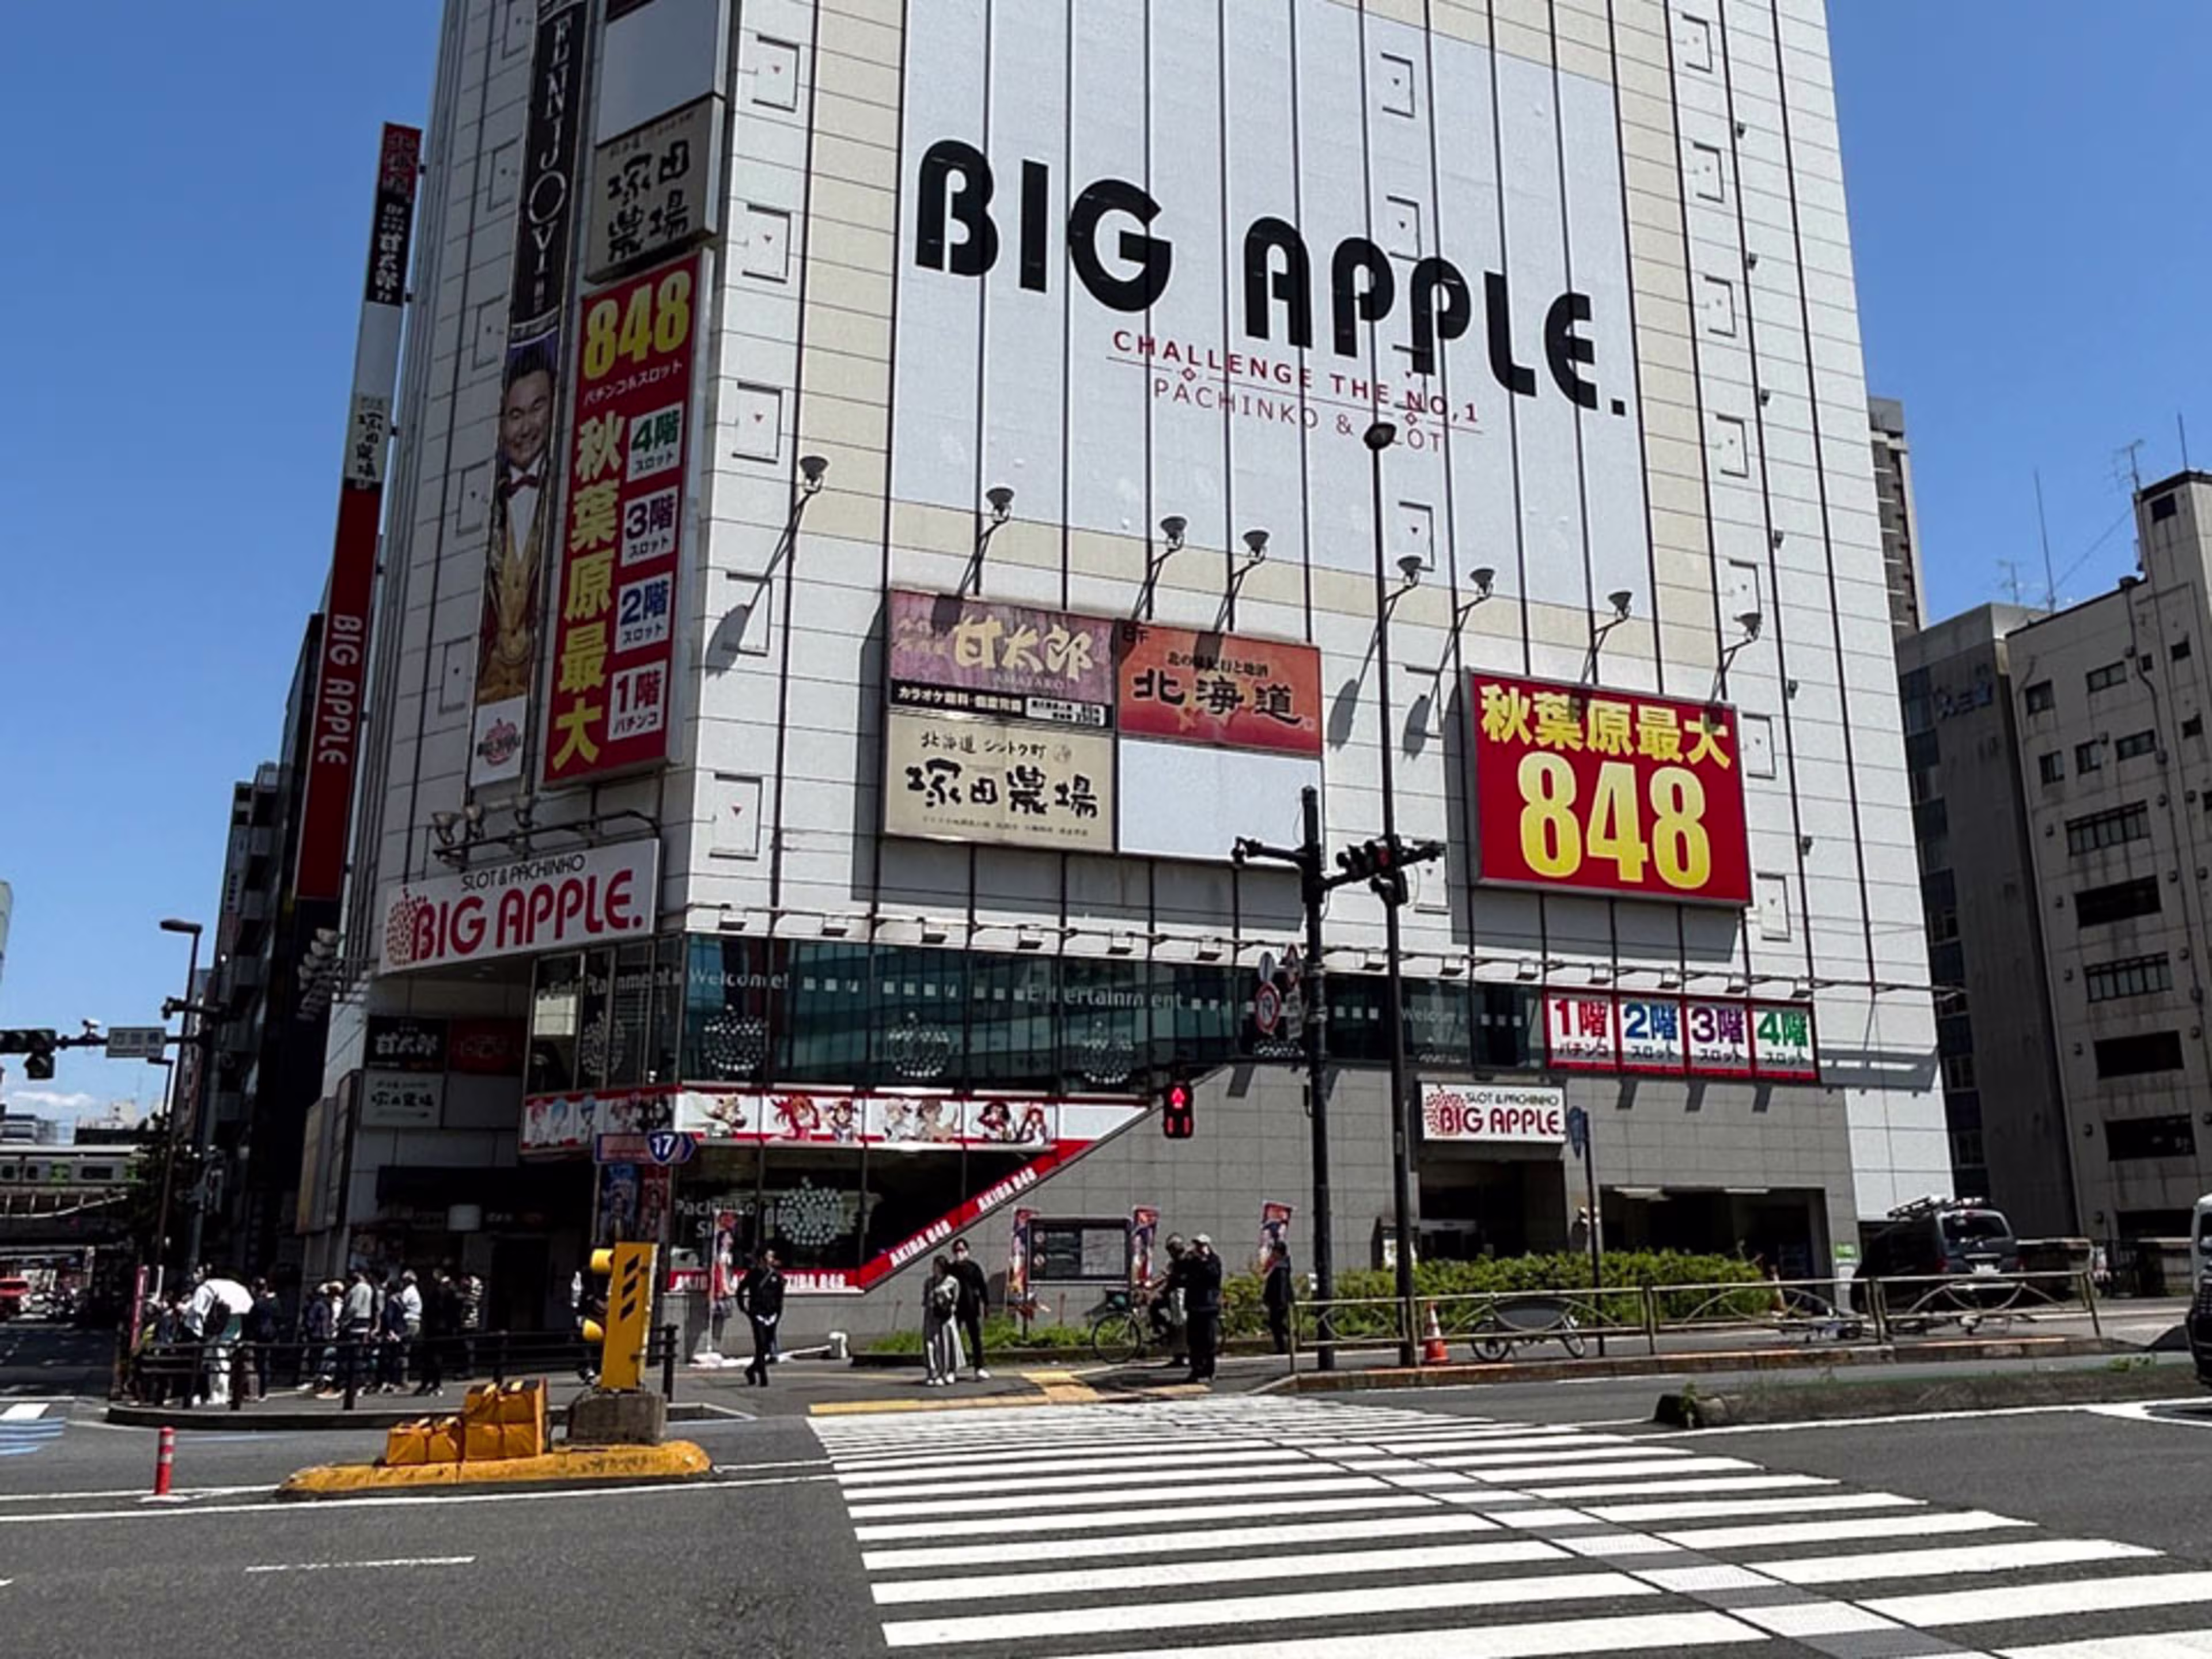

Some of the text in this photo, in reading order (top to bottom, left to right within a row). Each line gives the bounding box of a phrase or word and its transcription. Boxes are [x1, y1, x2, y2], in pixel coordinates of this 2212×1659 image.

[915, 138, 1172, 312] BIG
[583, 270, 691, 380] 848
[1113, 329, 1313, 389] CHALLENGE
[1154, 377, 1320, 429] PACHINKO
[1336, 413, 1354, 436] &
[1330, 373, 1389, 404] THE
[631, 407, 679, 453] 4階
[634, 449, 675, 472] スロット
[624, 495, 674, 539] 3階
[628, 536, 669, 559] スロット
[551, 410, 626, 771] 秋葉原最大
[619, 579, 668, 626] 2階
[622, 622, 665, 644] スロット
[952, 614, 1094, 683] 甘太郎
[318, 613, 363, 765] BIG APPLE
[615, 668, 661, 714] 1階
[1132, 668, 1303, 726] 北海道
[613, 711, 658, 734] パチンコ
[1479, 683, 1731, 770] 秋葉原最大
[1517, 751, 1711, 889] 848
[461, 870, 497, 892] SLOT
[411, 895, 487, 961] BIG
[1554, 1003, 1608, 1038] 1階
[1623, 1002, 1678, 1042] 2階
[1691, 1006, 1745, 1044] 3階
[1757, 1011, 1809, 1048] 4階
[1558, 1043, 1609, 1059] パチンコ
[1630, 1044, 1676, 1060] スロット
[1699, 1048, 1743, 1064] スロット
[1763, 1050, 1807, 1066] スロット
[1440, 1106, 1483, 1134] BIG
[652, 1134, 675, 1157] 17
[889, 1218, 952, 1268] AKIBA 848
